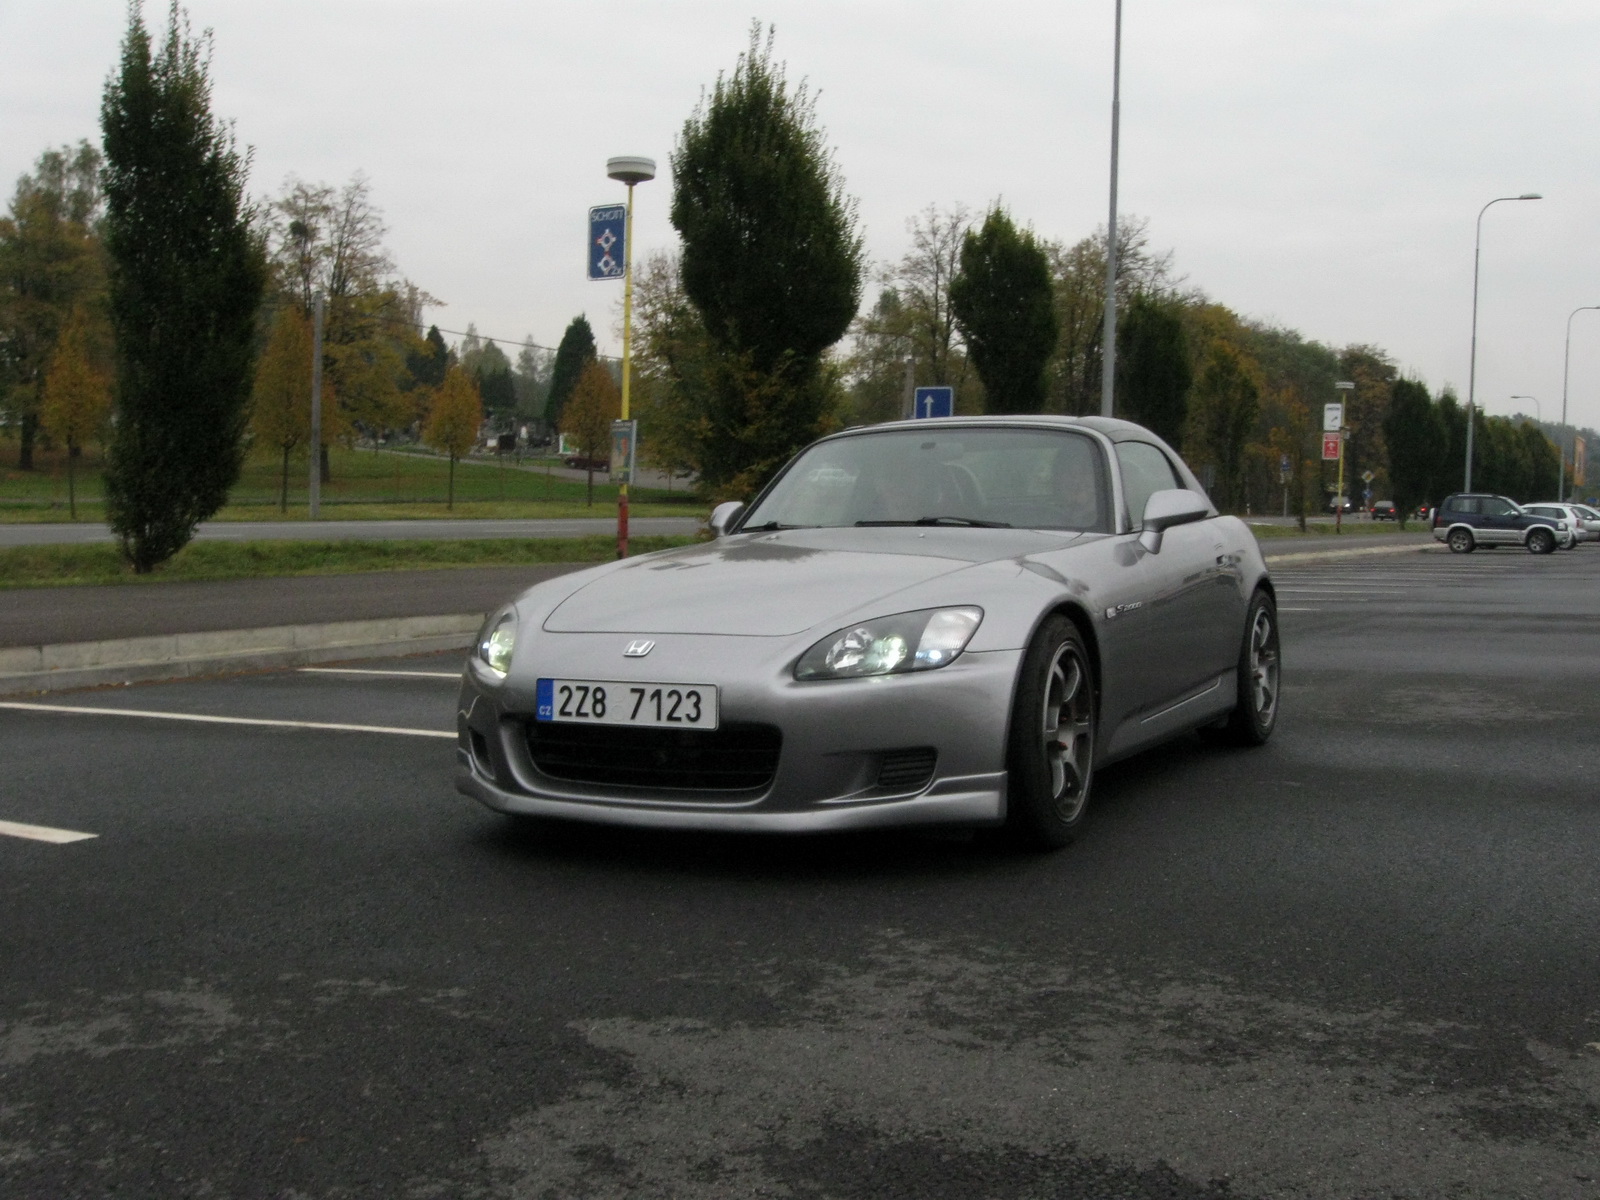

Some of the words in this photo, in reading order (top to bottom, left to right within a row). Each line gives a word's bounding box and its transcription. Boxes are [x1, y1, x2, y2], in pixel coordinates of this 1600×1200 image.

[538, 705, 552, 716] CZ
[558, 685, 607, 718] 2Z8
[629, 687, 702, 723] 7123
